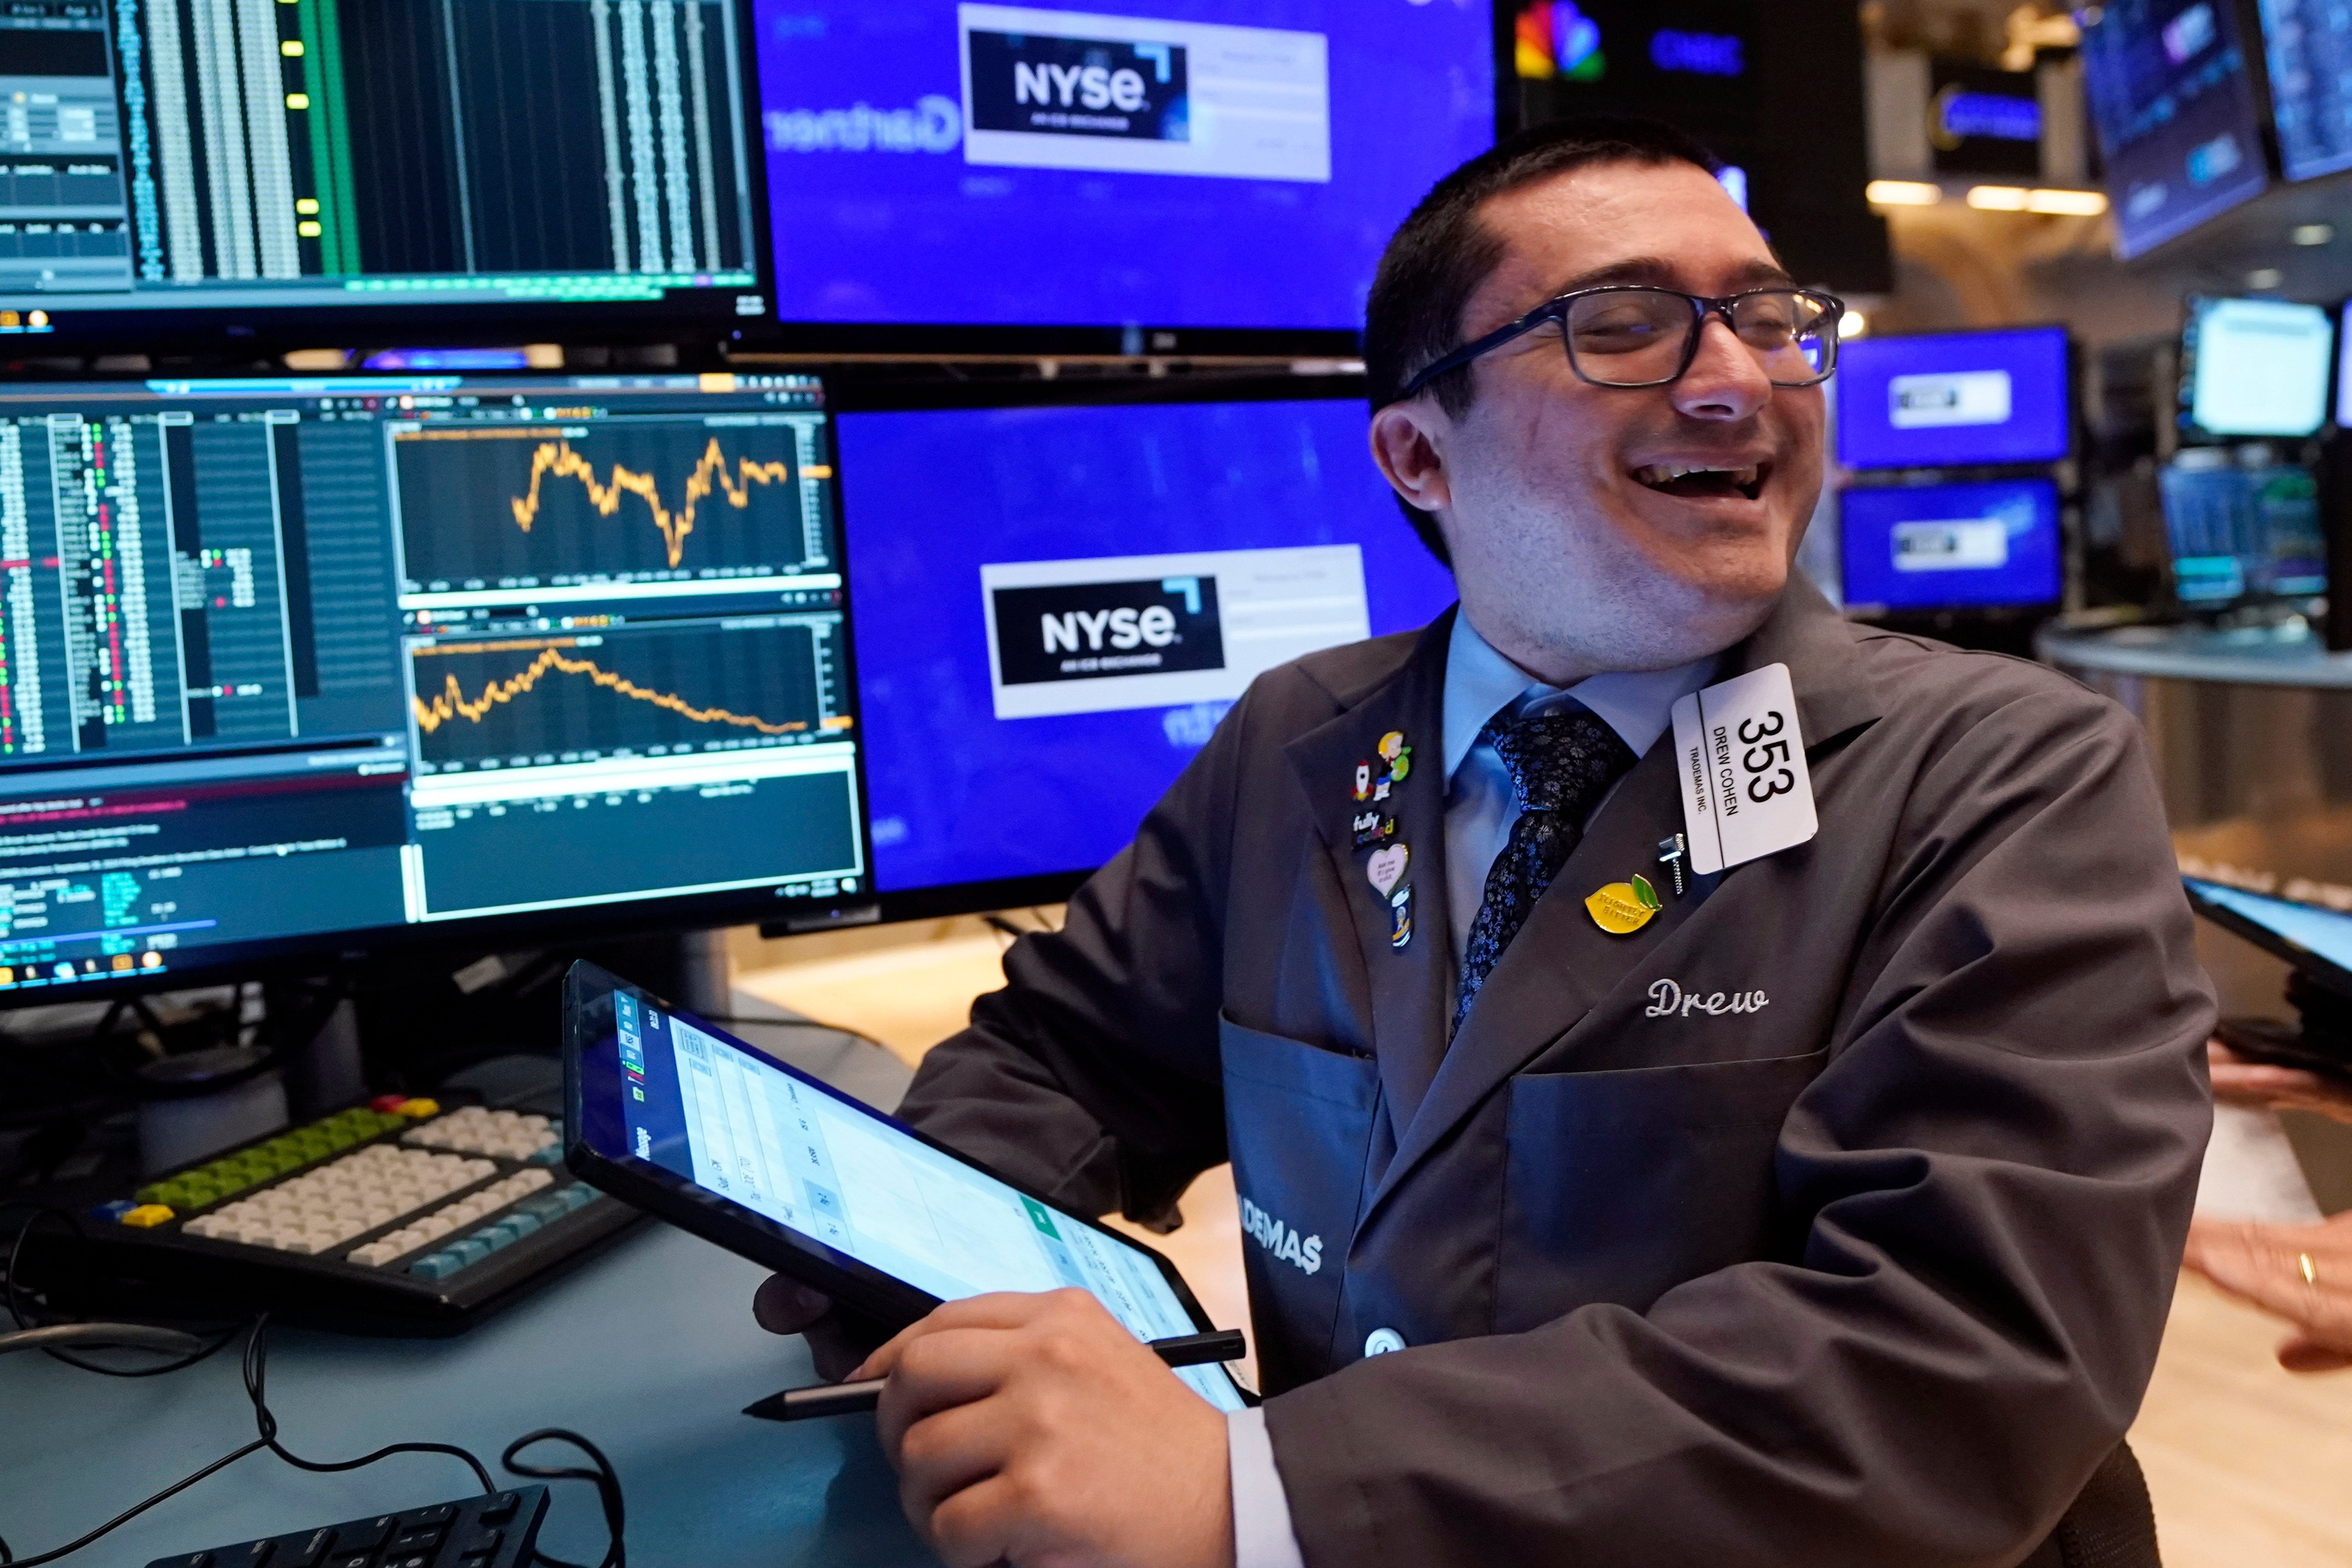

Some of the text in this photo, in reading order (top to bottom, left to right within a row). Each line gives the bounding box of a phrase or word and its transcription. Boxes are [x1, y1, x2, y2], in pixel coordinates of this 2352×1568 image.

[1689, 746, 1707, 815] TRADEMAS INC.
[1713, 726, 1739, 816] DREW COHEN
[1738, 711, 1794, 803] 353
[1599, 892, 1646, 917] SLIGHTLY
[1603, 905, 1640, 925] BITTER
[1645, 978, 1769, 1018] Drew
[635, 1127, 652, 1161] Message
[1238, 1196, 1323, 1274] DEMA$
